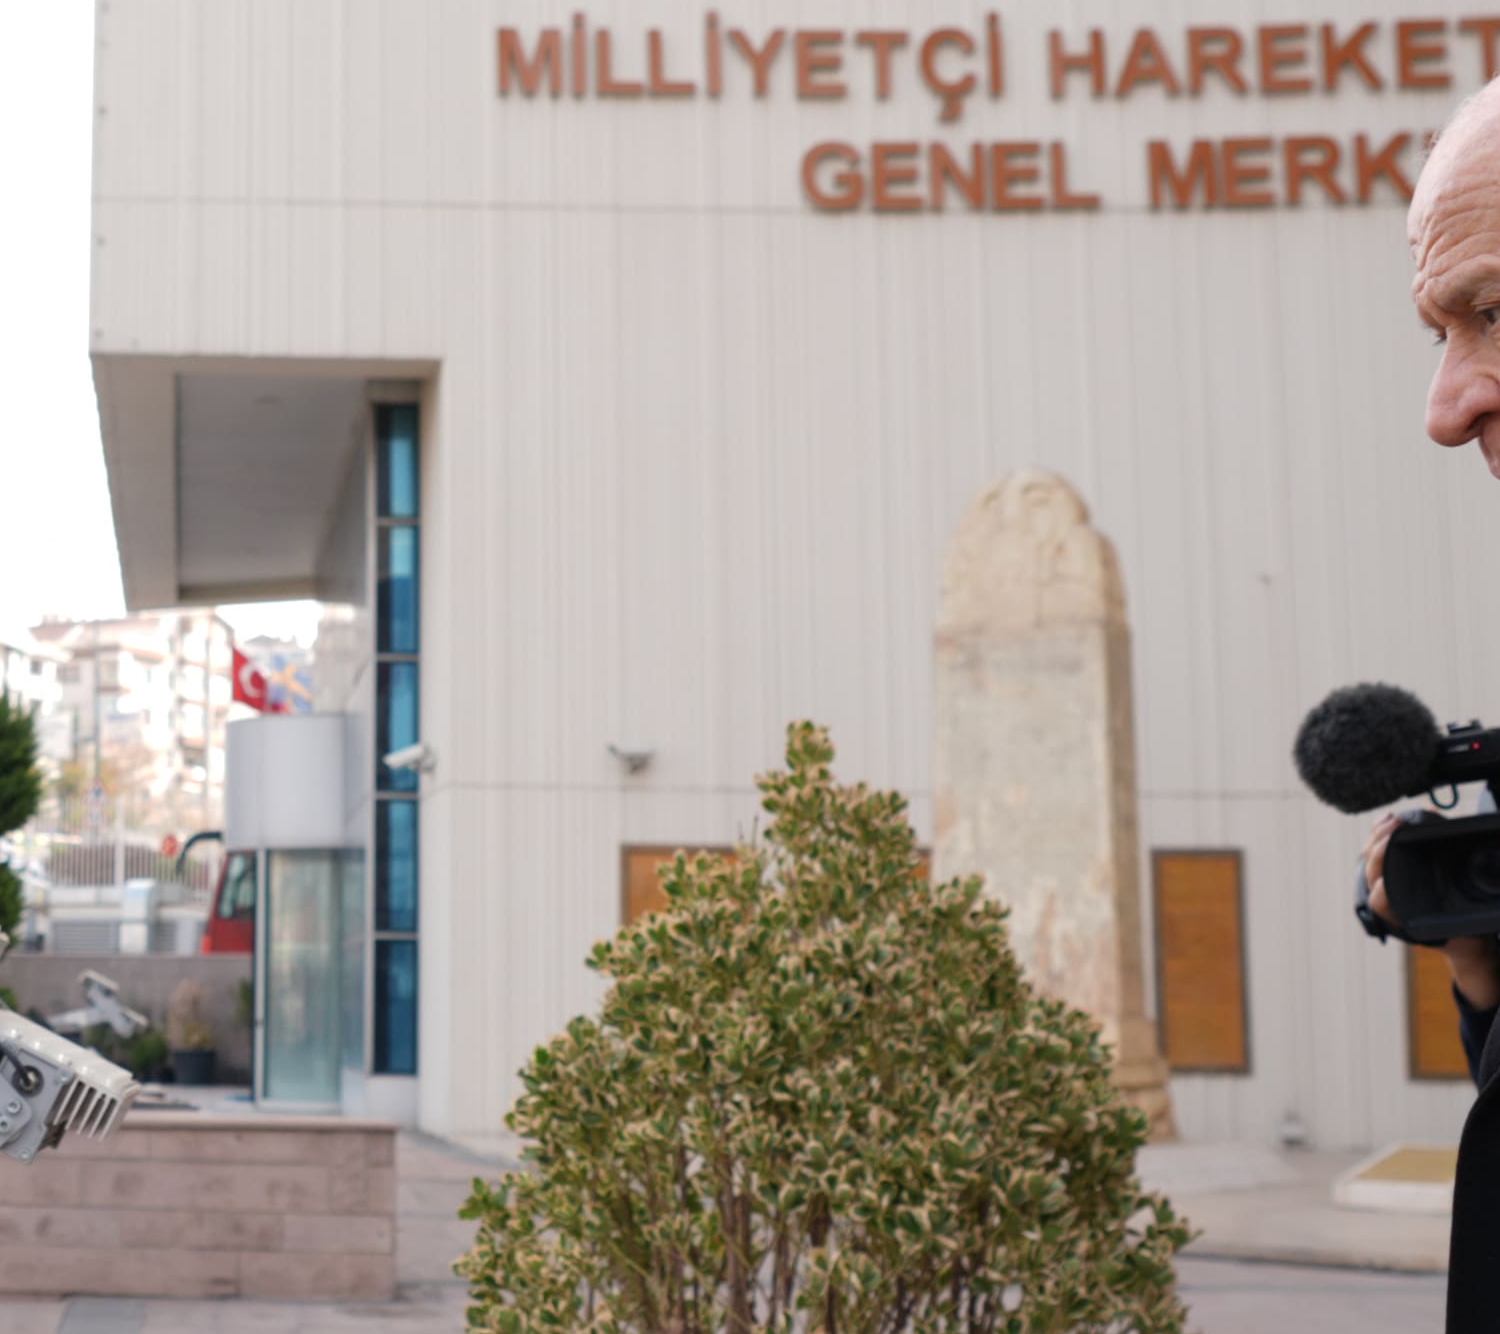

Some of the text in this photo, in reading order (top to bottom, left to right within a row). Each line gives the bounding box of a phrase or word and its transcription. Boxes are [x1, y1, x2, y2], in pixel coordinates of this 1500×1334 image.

[496, 11, 1005, 125] MİLLİYETÇİ
[800, 133, 1438, 214] GENEL MERK
